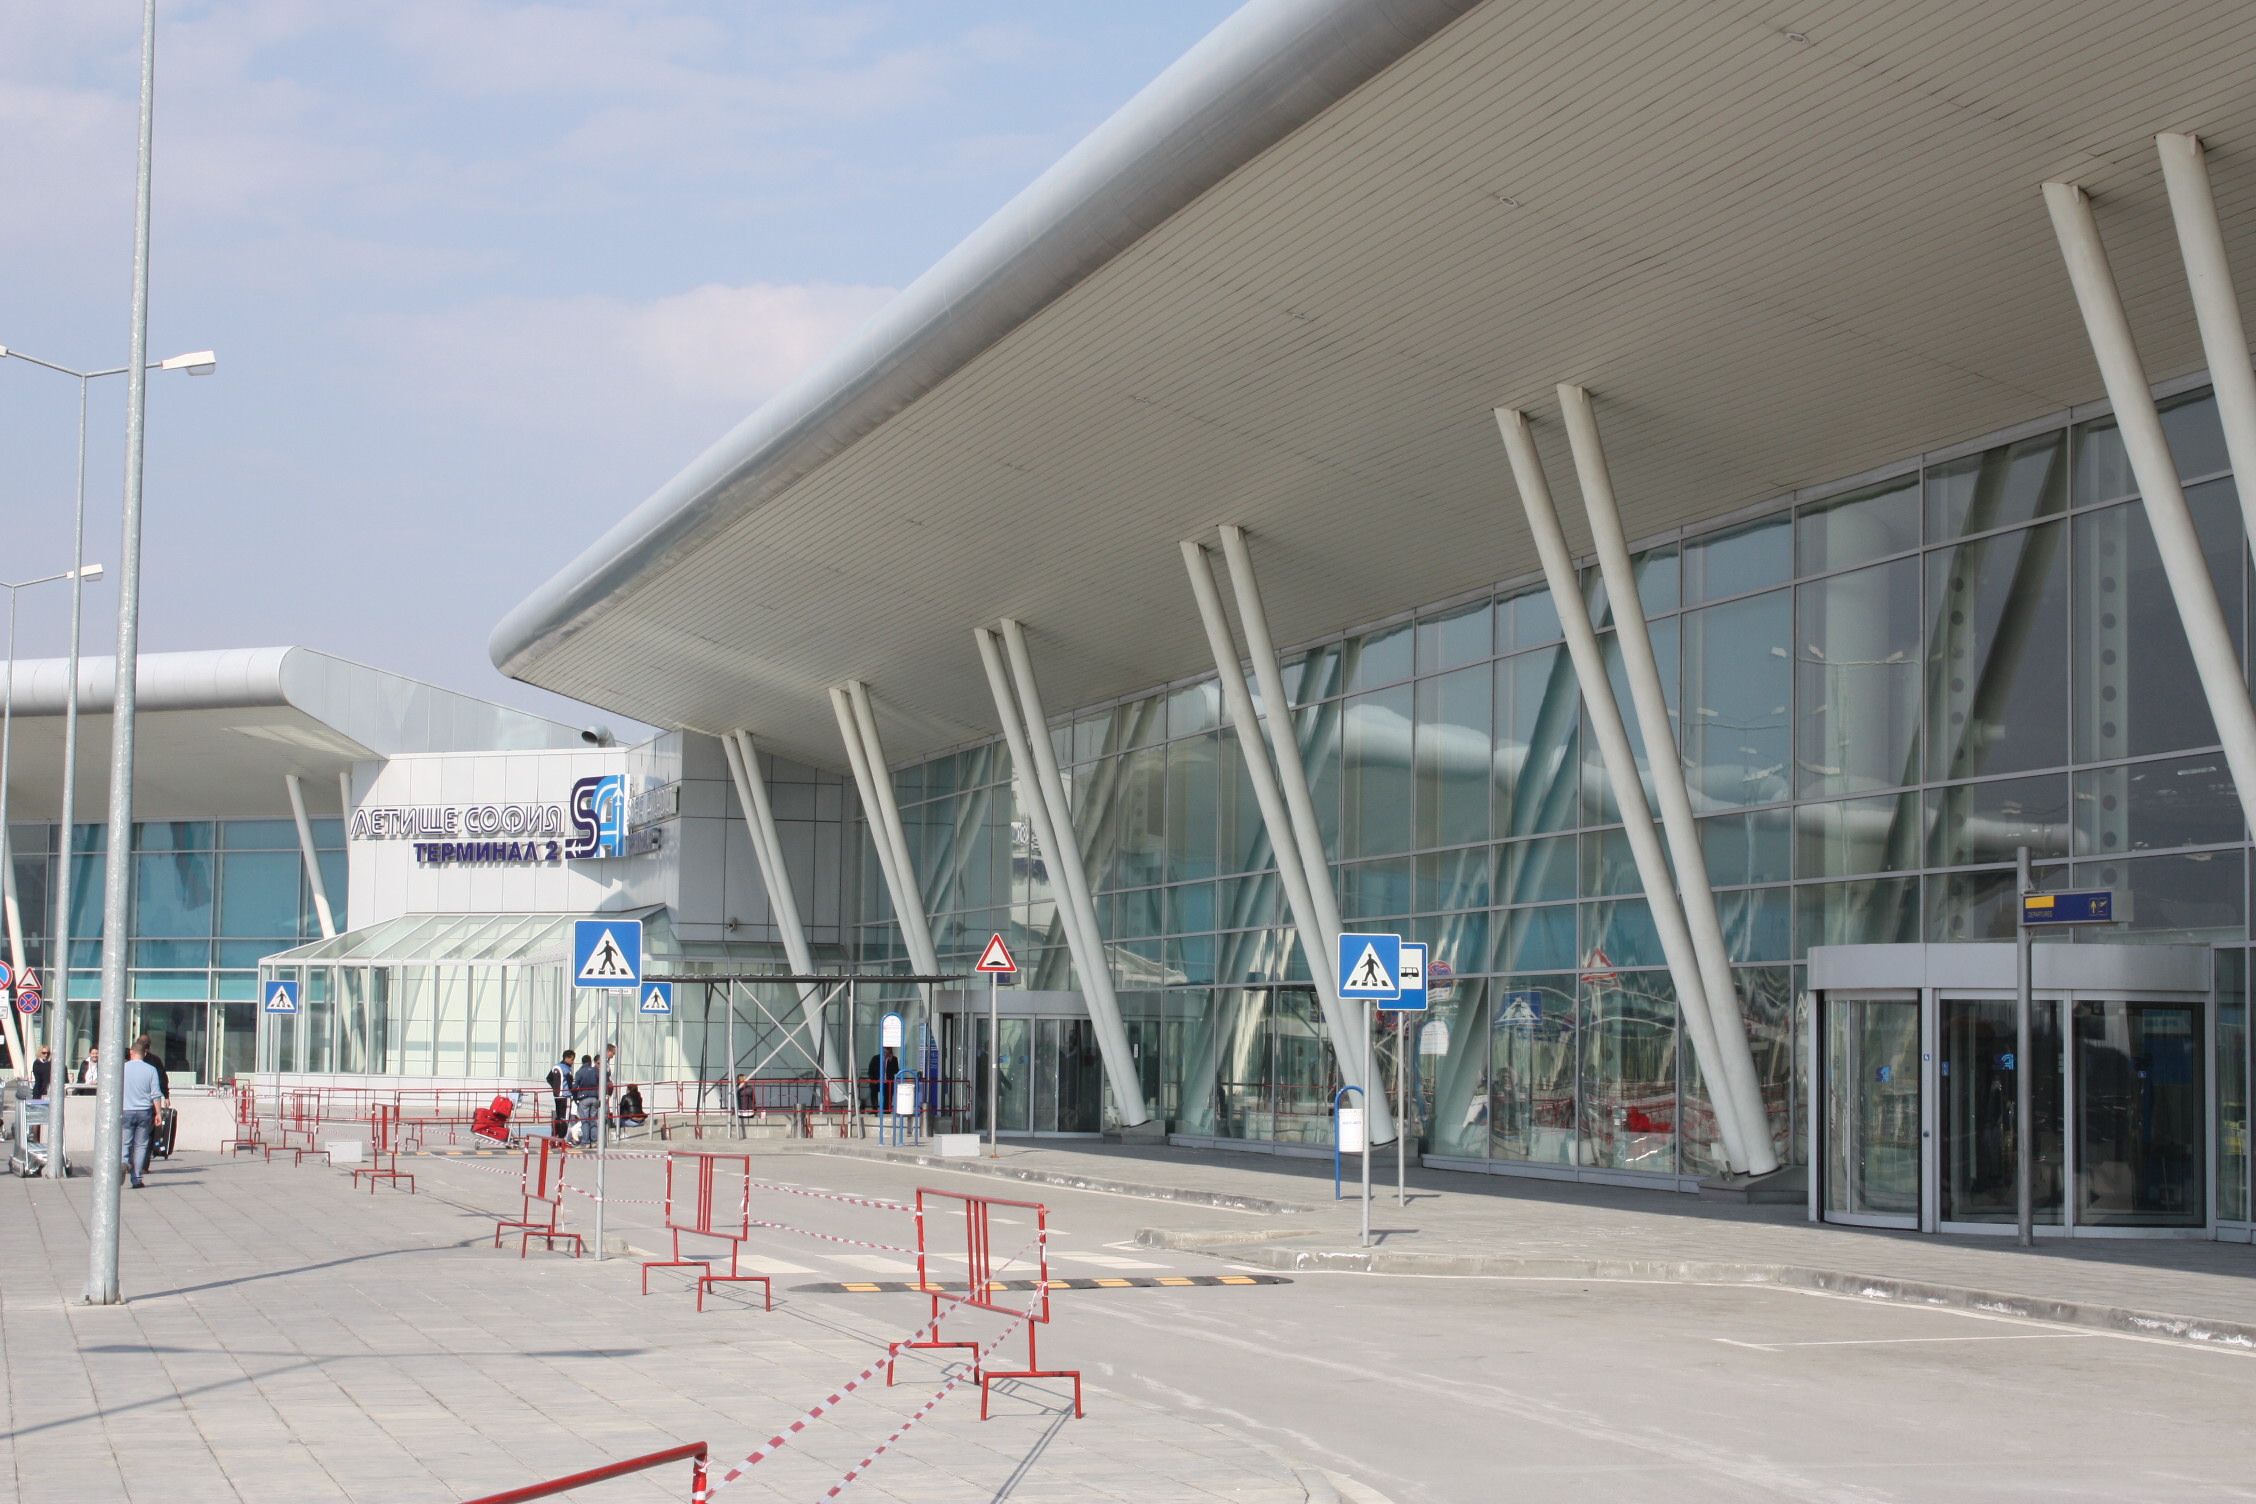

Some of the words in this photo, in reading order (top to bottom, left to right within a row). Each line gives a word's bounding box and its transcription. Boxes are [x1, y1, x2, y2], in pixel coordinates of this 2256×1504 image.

[351, 807, 457, 837] ЛЕТИЩЕ
[464, 805, 563, 834] СОФИЯ
[412, 841, 539, 863] ТЕРМИНАЛ
[544, 840, 559, 861] 2
